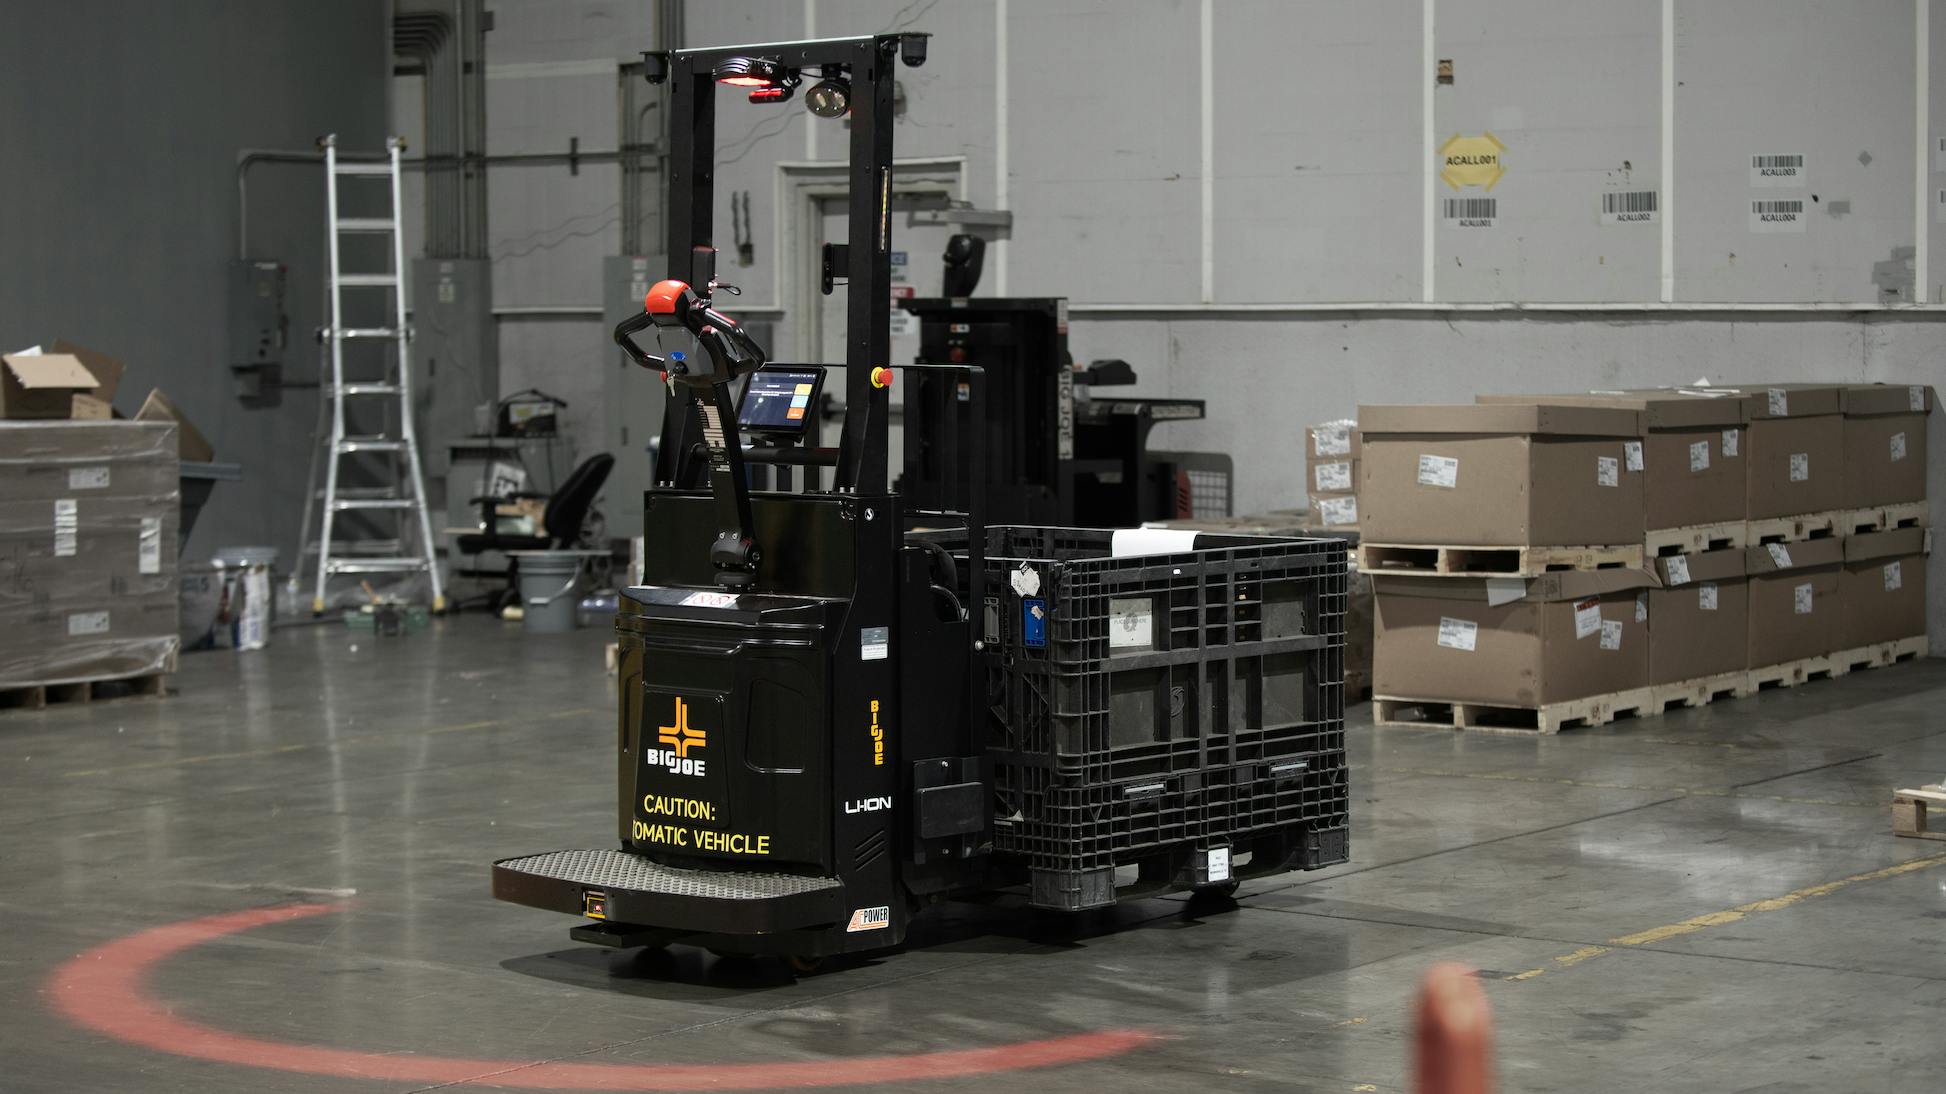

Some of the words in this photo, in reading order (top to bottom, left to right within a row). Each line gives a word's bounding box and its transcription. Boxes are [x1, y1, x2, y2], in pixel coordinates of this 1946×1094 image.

[1446, 155, 1496, 166] ACALL001
[1760, 168, 1797, 177] ACALL003
[1616, 213, 1651, 222] ACALL002
[1760, 214, 1797, 222] ACALL004
[644, 794, 716, 821] CAUTION:
[693, 830, 770, 855] VEHICLE
[863, 907, 888, 923] POWER
